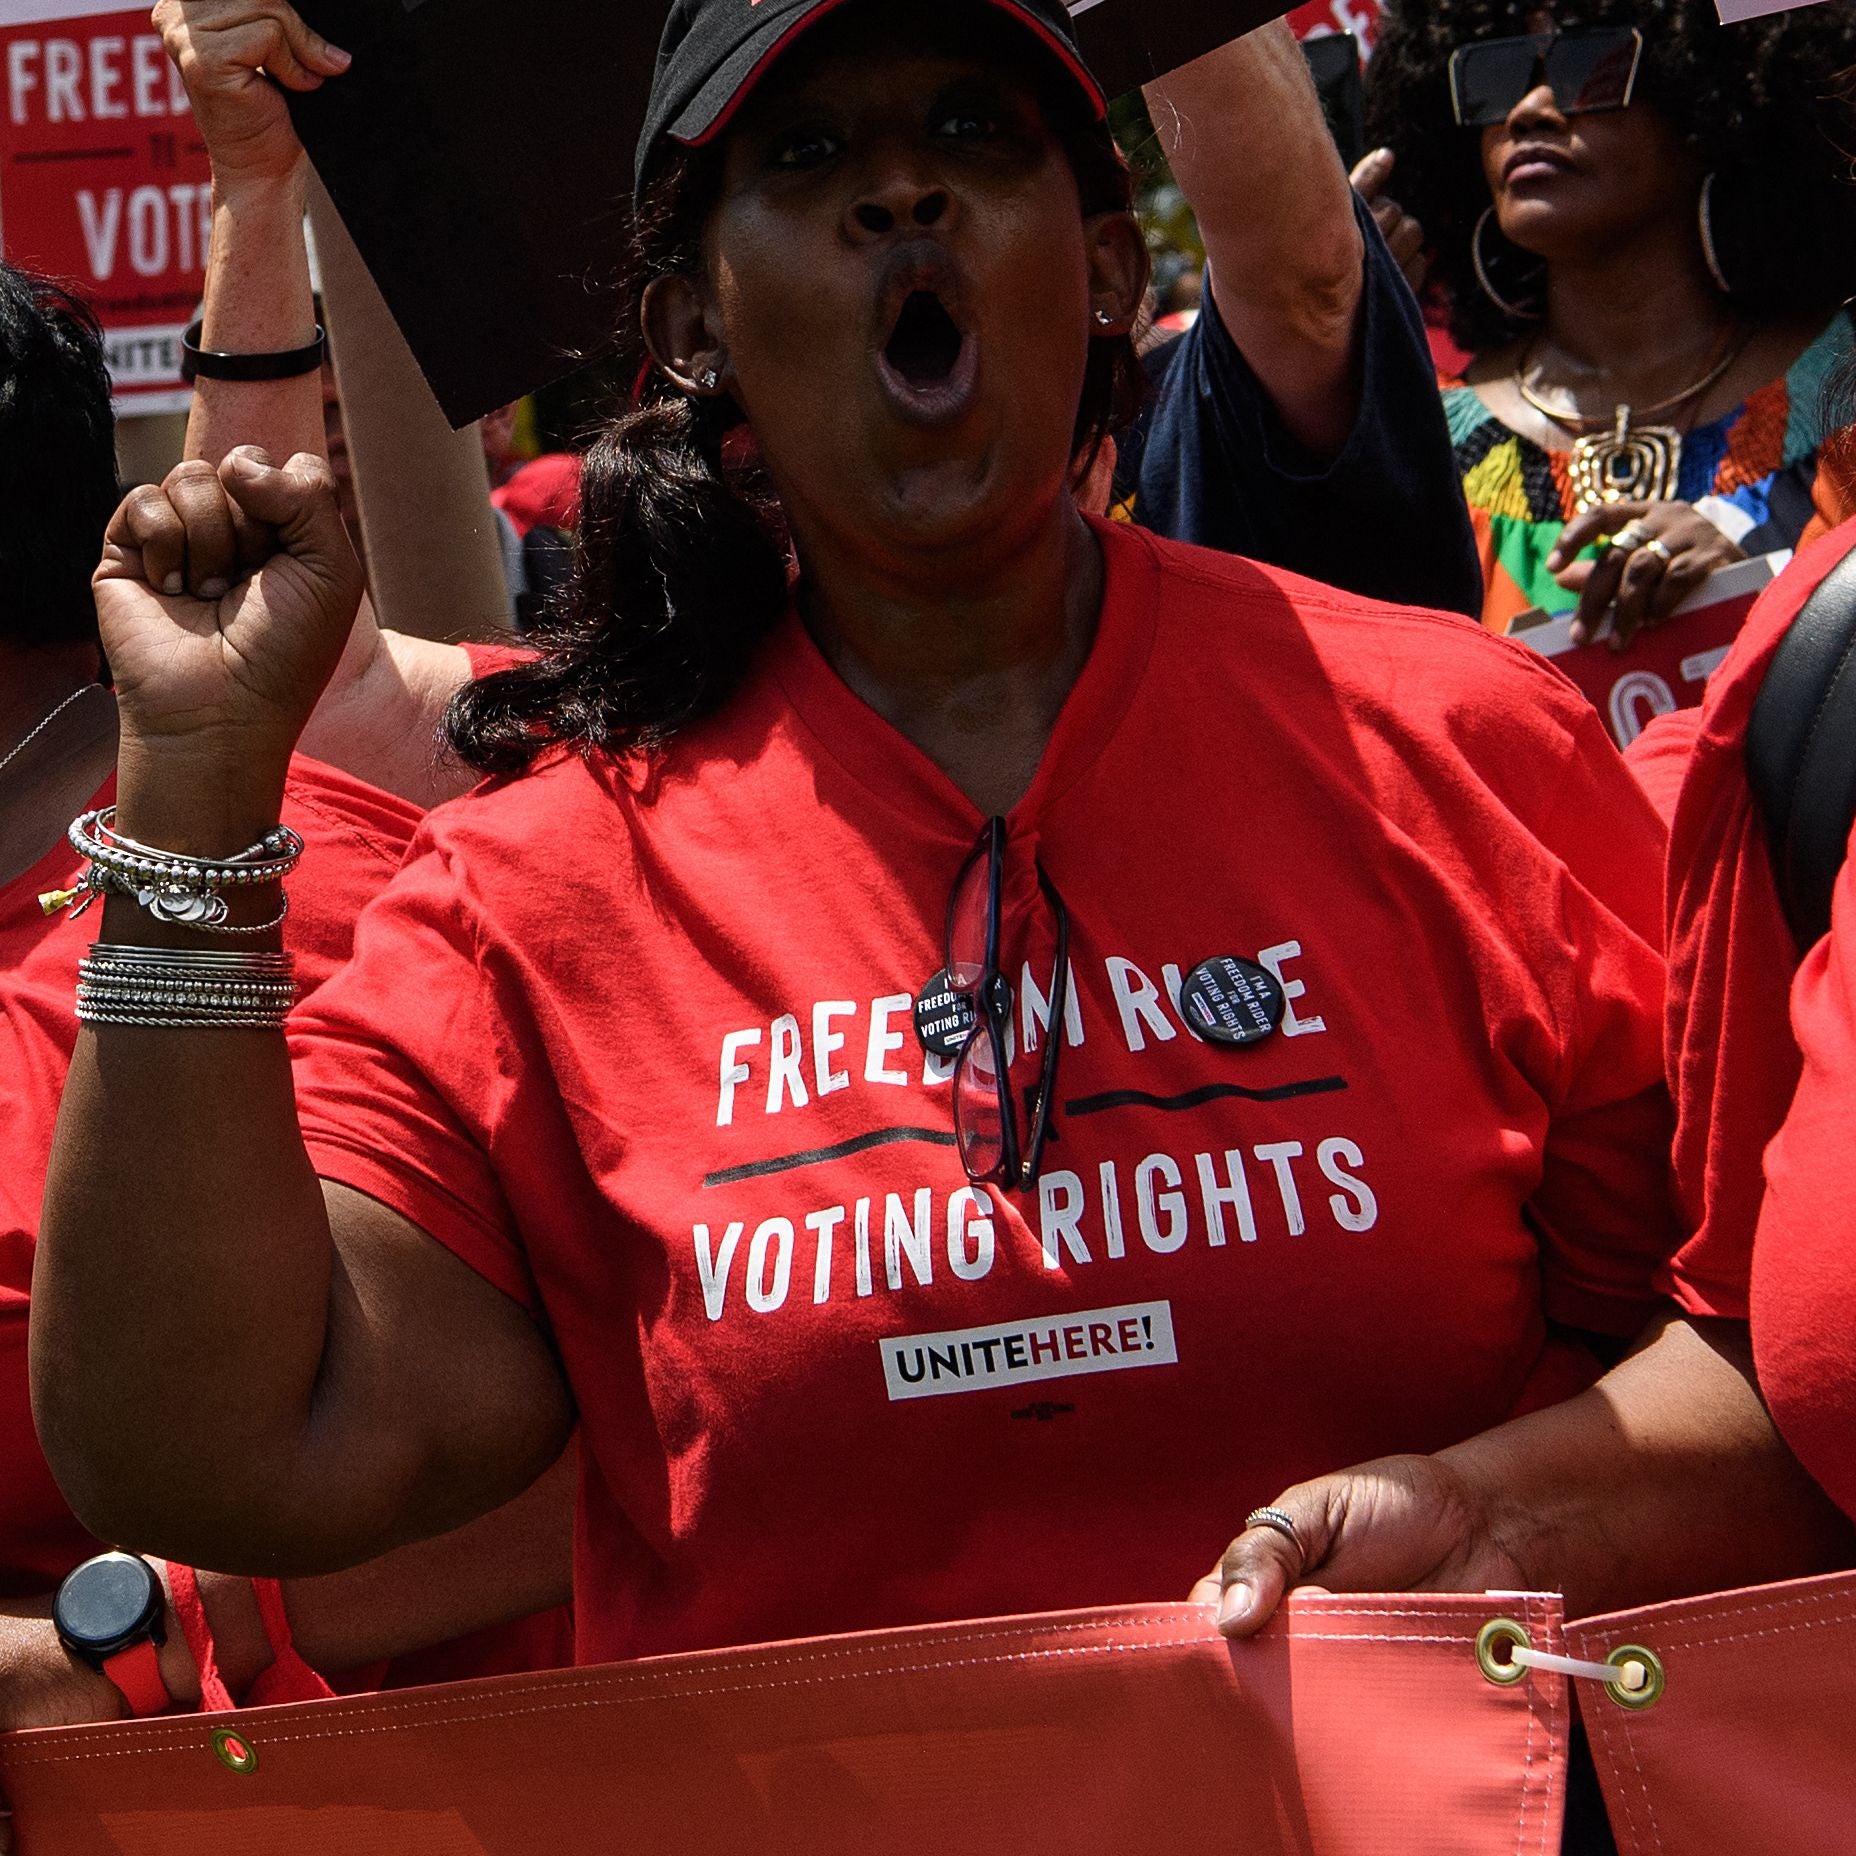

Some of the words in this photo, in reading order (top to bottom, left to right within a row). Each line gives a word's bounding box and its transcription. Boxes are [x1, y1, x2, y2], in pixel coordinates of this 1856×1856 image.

[7, 33, 191, 126] FREE
[920, 1014, 960, 1038] VOTING
[1195, 967, 1225, 1003] VOTING
[1216, 1001, 1247, 1041] RIGHTS
[1219, 957, 1256, 1002] FREEDOM
[1247, 1000, 1273, 1033] RIDER
[691, 1184, 997, 1322] VOTING
[1037, 1135, 1382, 1272] RIGHTS
[896, 1313, 1156, 1386] UNITEHERE!
